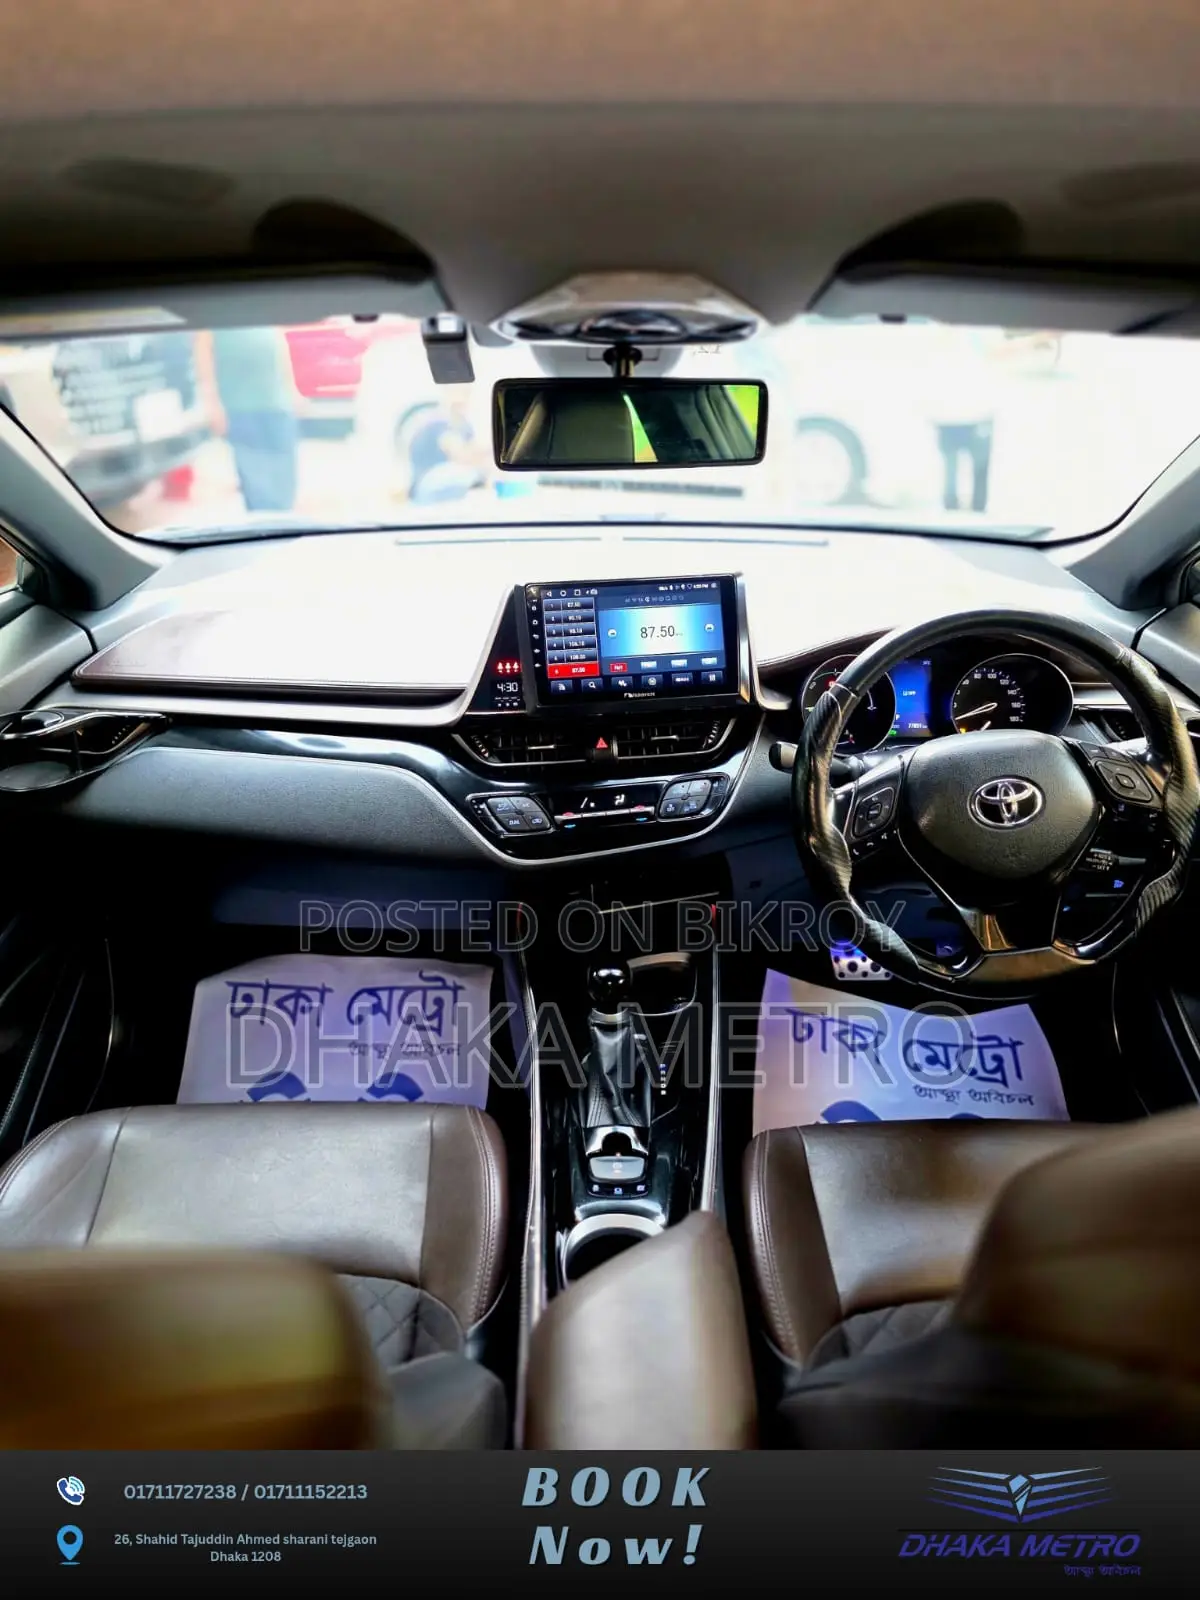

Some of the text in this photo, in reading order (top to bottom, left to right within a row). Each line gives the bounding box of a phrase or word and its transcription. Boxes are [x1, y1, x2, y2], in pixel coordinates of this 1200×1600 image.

[640, 625, 676, 639] 87.50
[496, 682, 519, 693] 4:30
[225, 969, 466, 1038] ঢাকা মেট্রো
[784, 1007, 1026, 1089] ঢাকা মেট্রো
